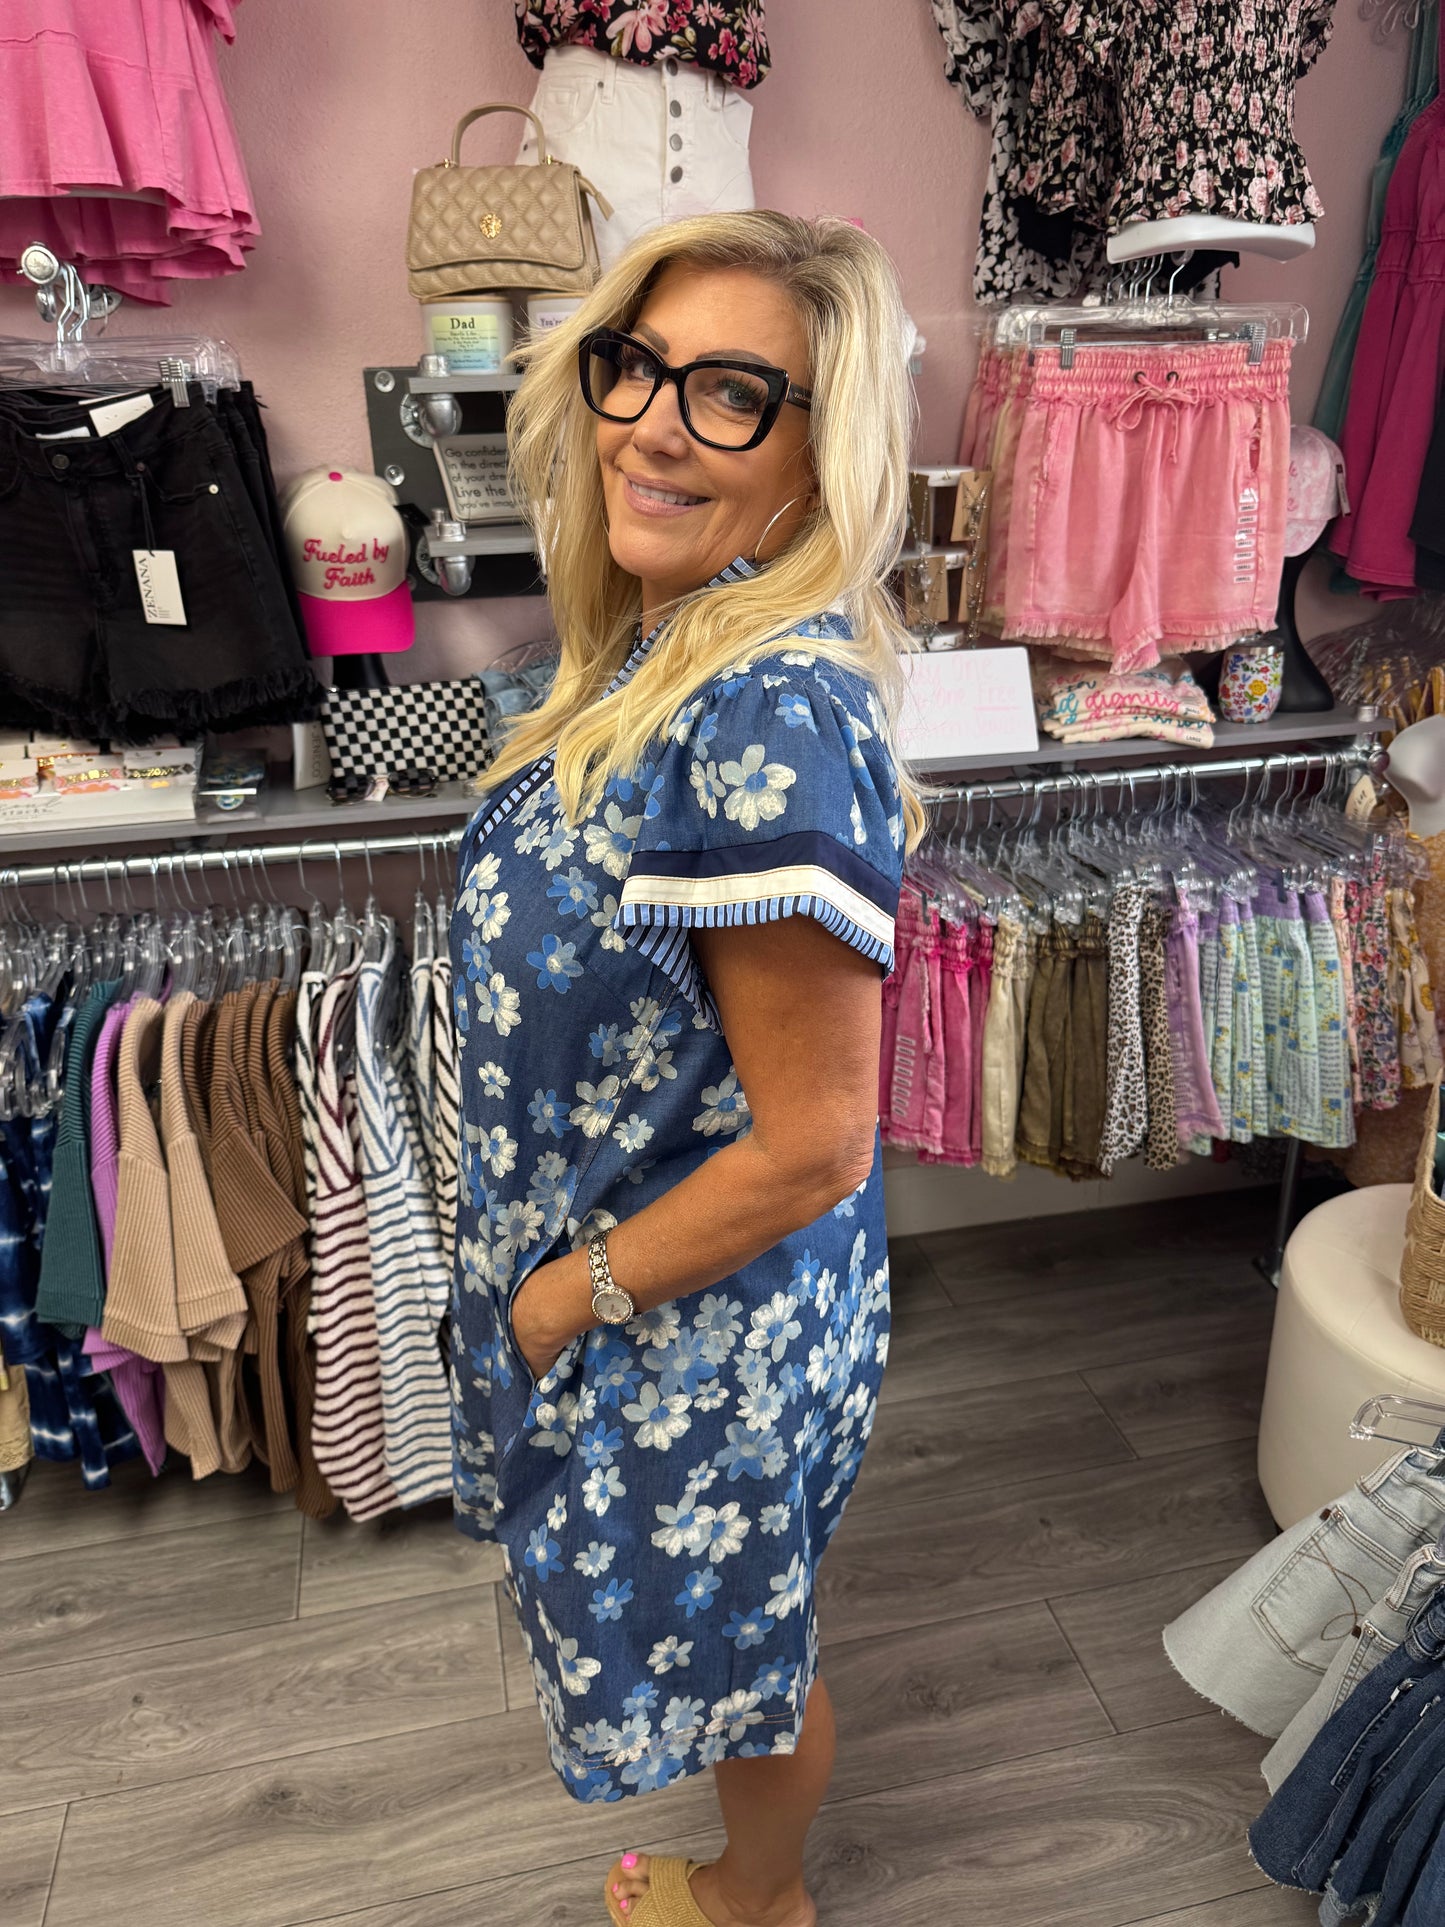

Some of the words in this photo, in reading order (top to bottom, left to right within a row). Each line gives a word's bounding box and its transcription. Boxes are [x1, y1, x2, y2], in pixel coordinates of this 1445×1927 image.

[450, 317, 475, 329] Dad
[445, 448, 462, 457] Go
[460, 460, 477, 469] the
[452, 473, 461, 481] of
[464, 475, 485, 483] your
[454, 486, 481, 497] Live
[485, 484, 506, 496] the
[303, 539, 368, 564] Fueled
[373, 538, 389, 564] by
[324, 567, 376, 590] Faith
[138, 558, 159, 618] ZENANA
[1085, 689, 1180, 717] dignity
